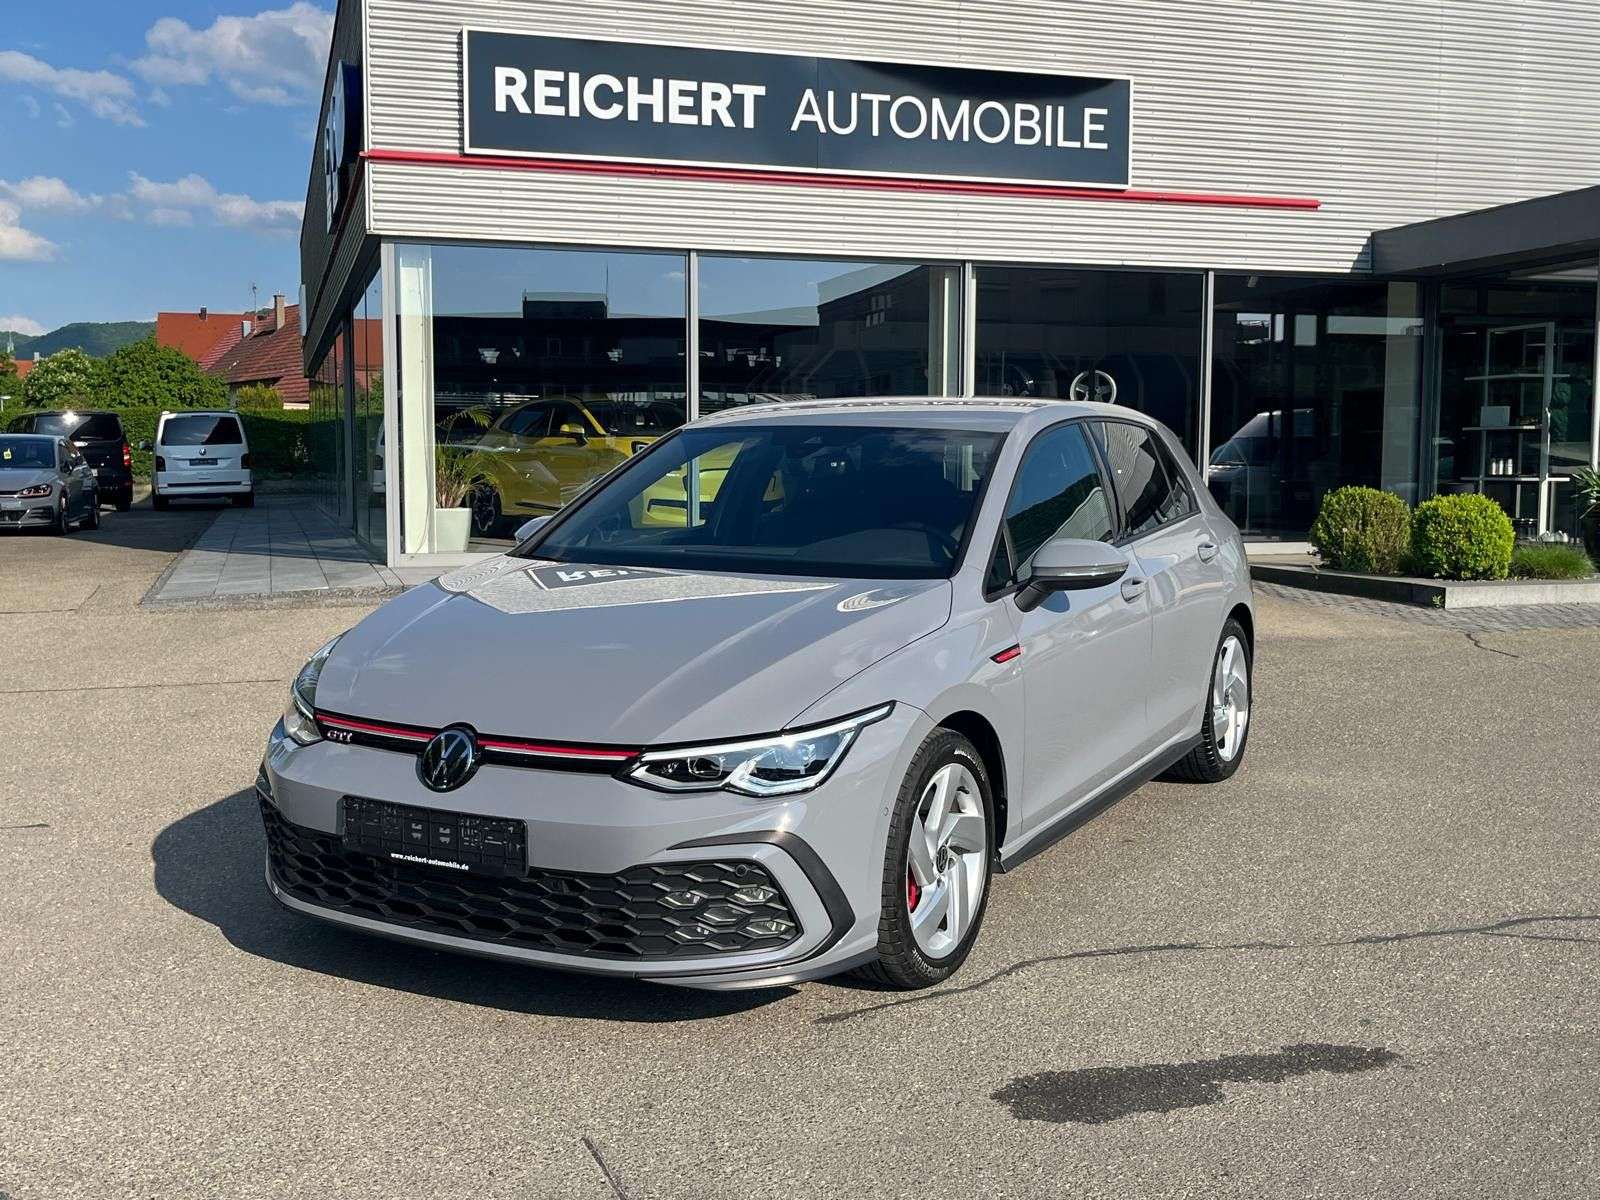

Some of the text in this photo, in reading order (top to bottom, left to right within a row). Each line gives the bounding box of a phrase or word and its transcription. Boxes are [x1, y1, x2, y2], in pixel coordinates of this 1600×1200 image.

[494, 66, 1108, 150] REICHERT AUTOMOBILE
[327, 730, 353, 743] GTI
[390, 852, 469, 871] www.reichert-automobile.de
